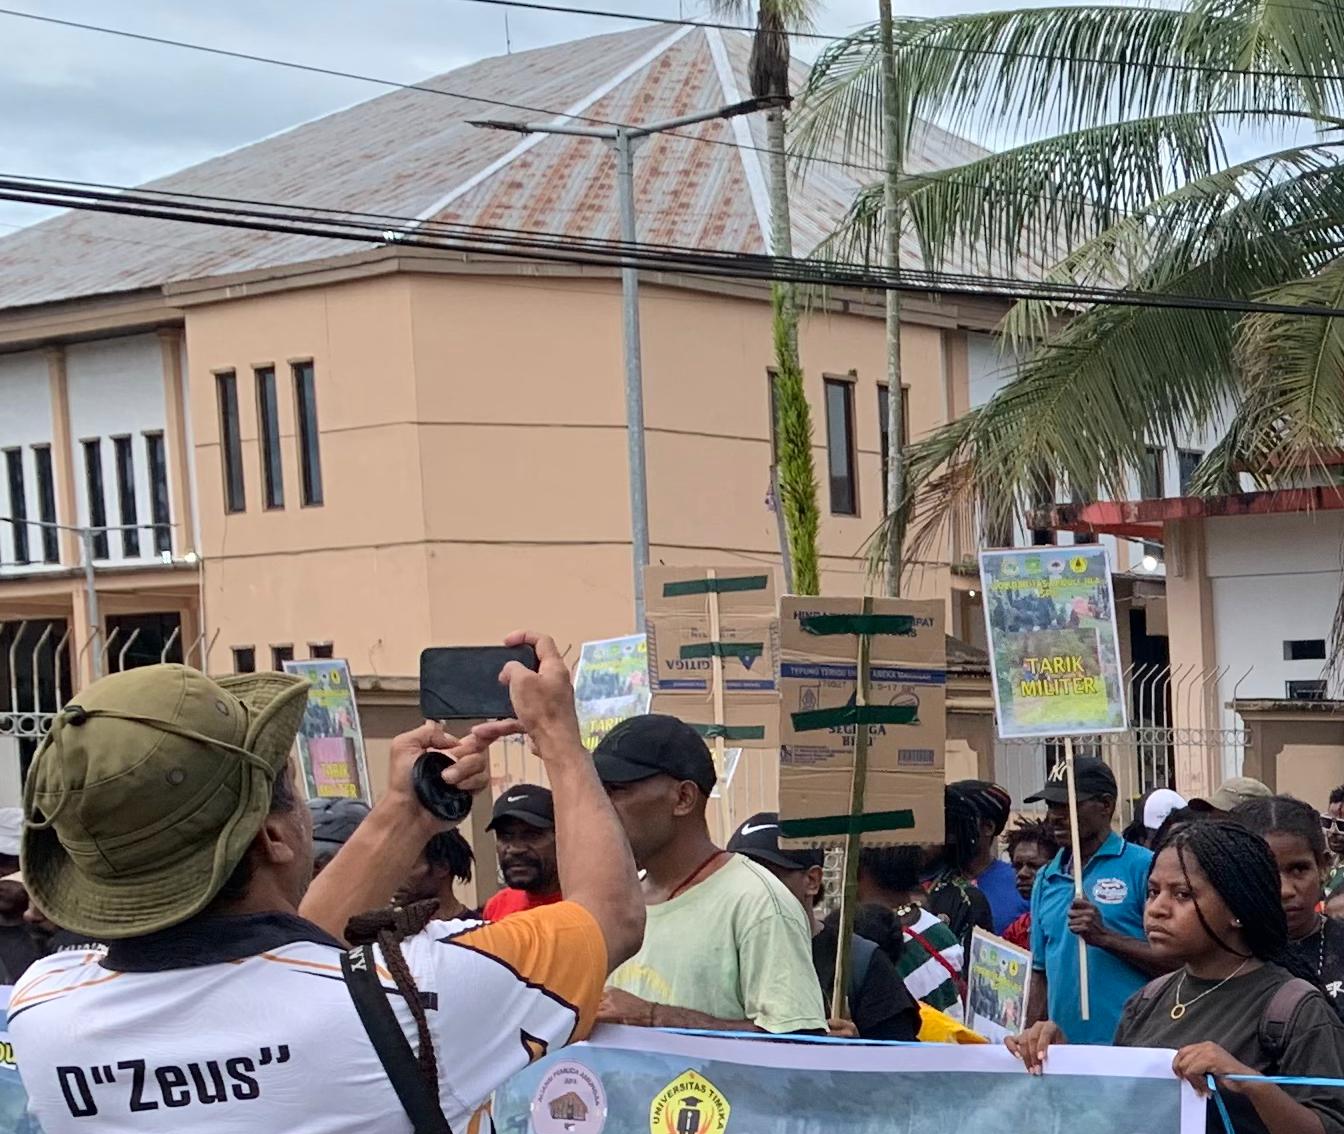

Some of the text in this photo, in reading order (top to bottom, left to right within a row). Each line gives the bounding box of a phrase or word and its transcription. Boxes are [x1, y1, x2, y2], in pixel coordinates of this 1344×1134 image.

[1023, 656, 1085, 674] TARIK
[1020, 676, 1098, 697] MILITER
[652, 1081, 725, 1131] UNIVERSITAS TIMIKA
